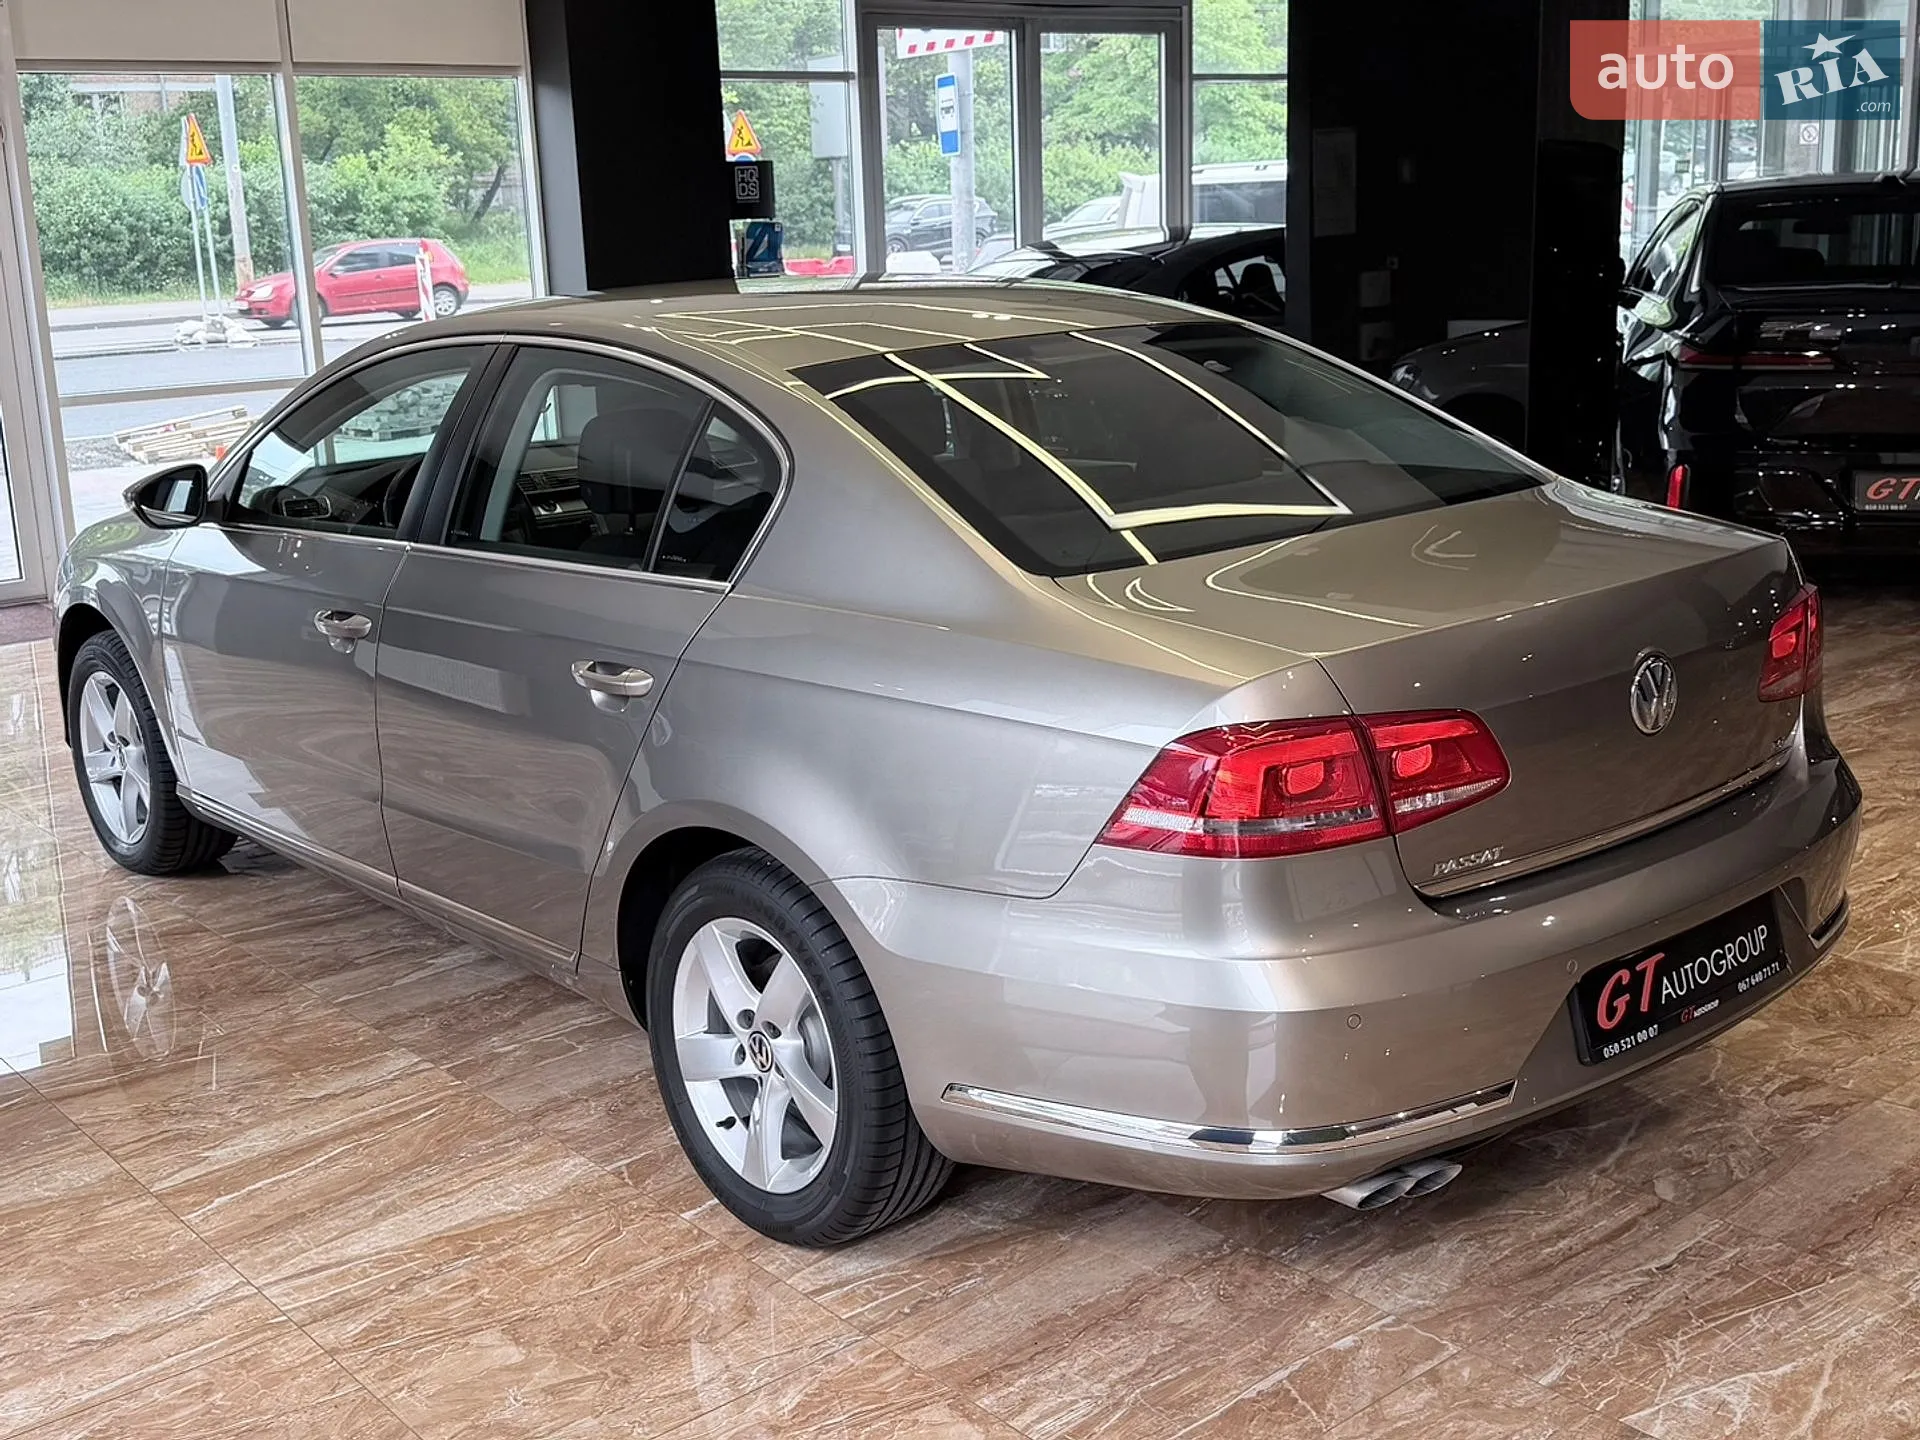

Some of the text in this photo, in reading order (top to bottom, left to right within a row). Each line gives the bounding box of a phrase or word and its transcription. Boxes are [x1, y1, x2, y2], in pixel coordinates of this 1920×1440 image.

[1433, 845, 1504, 877] PASSAT
[1596, 924, 1768, 1030] GT AUTOGROUP
[1603, 1024, 1658, 1058] 050 521 00 07
